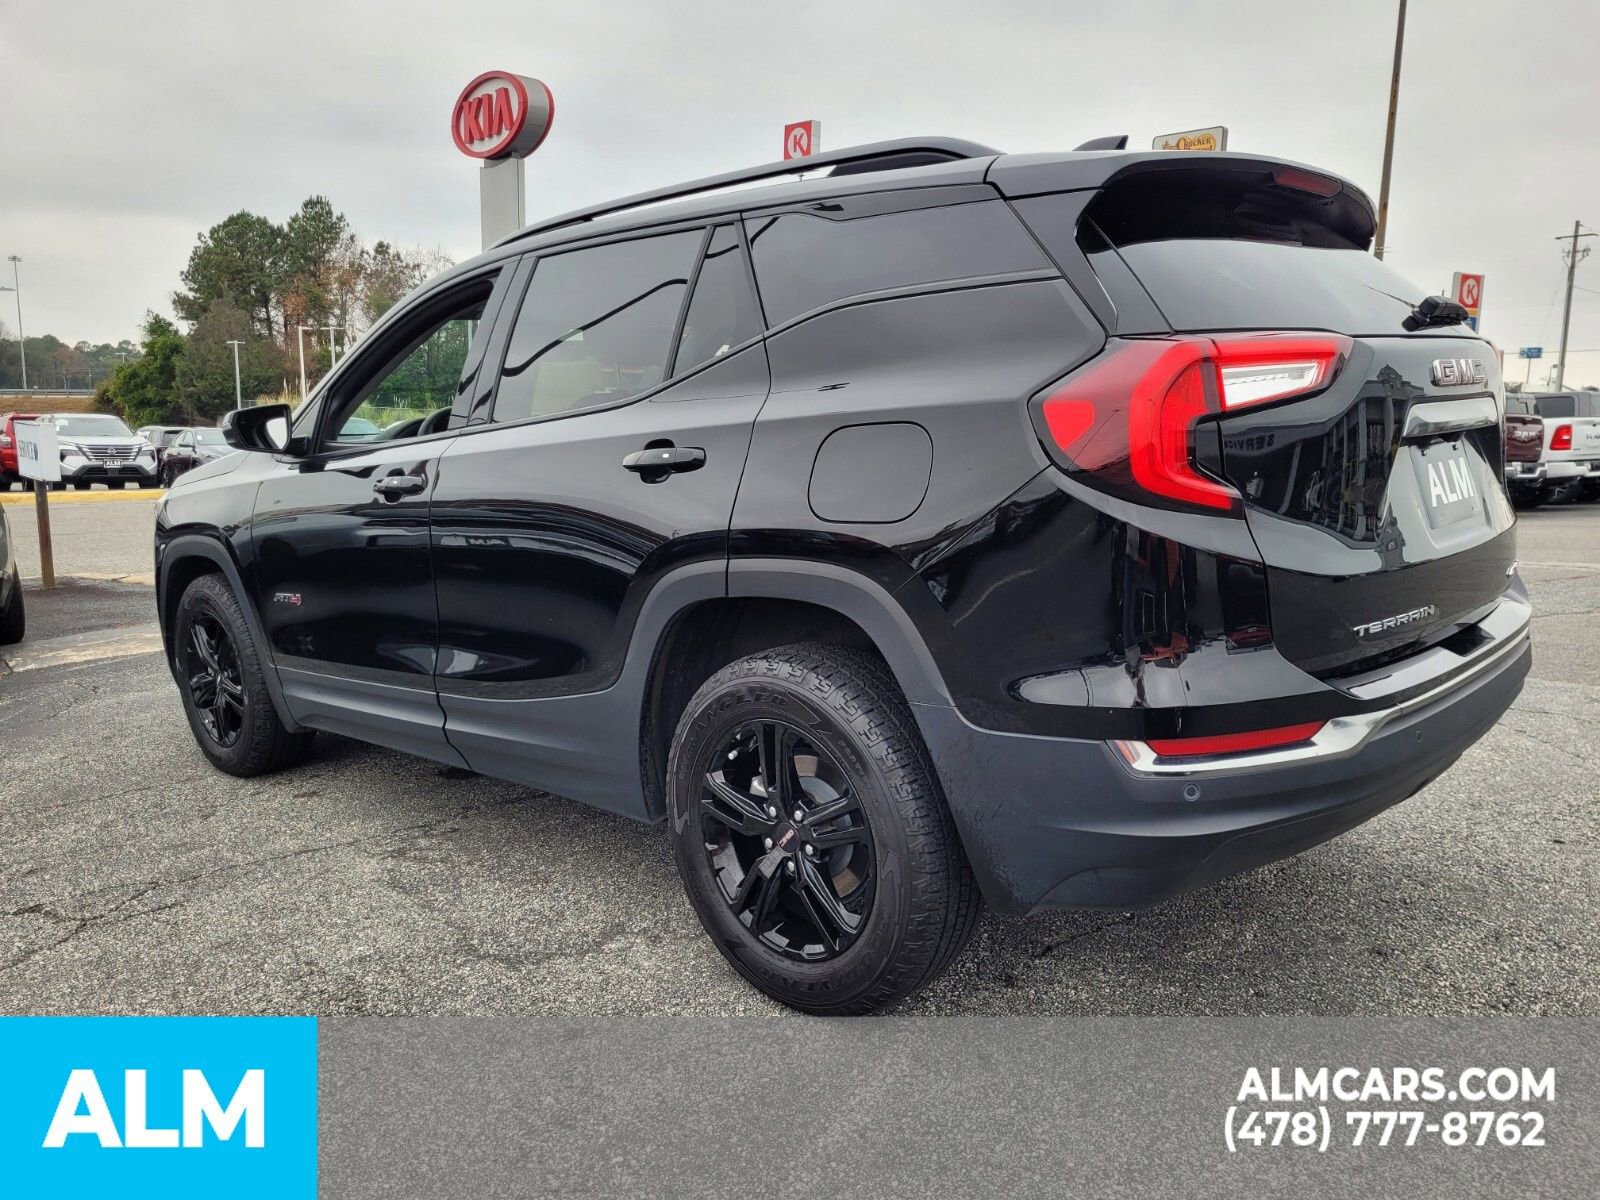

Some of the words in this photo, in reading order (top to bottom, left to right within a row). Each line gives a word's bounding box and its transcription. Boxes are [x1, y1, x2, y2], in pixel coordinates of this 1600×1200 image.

[462, 87, 515, 144] KIA
[1433, 359, 1487, 386] GMC
[1427, 457, 1475, 507] ALM
[1353, 605, 1435, 637] TERRAIN
